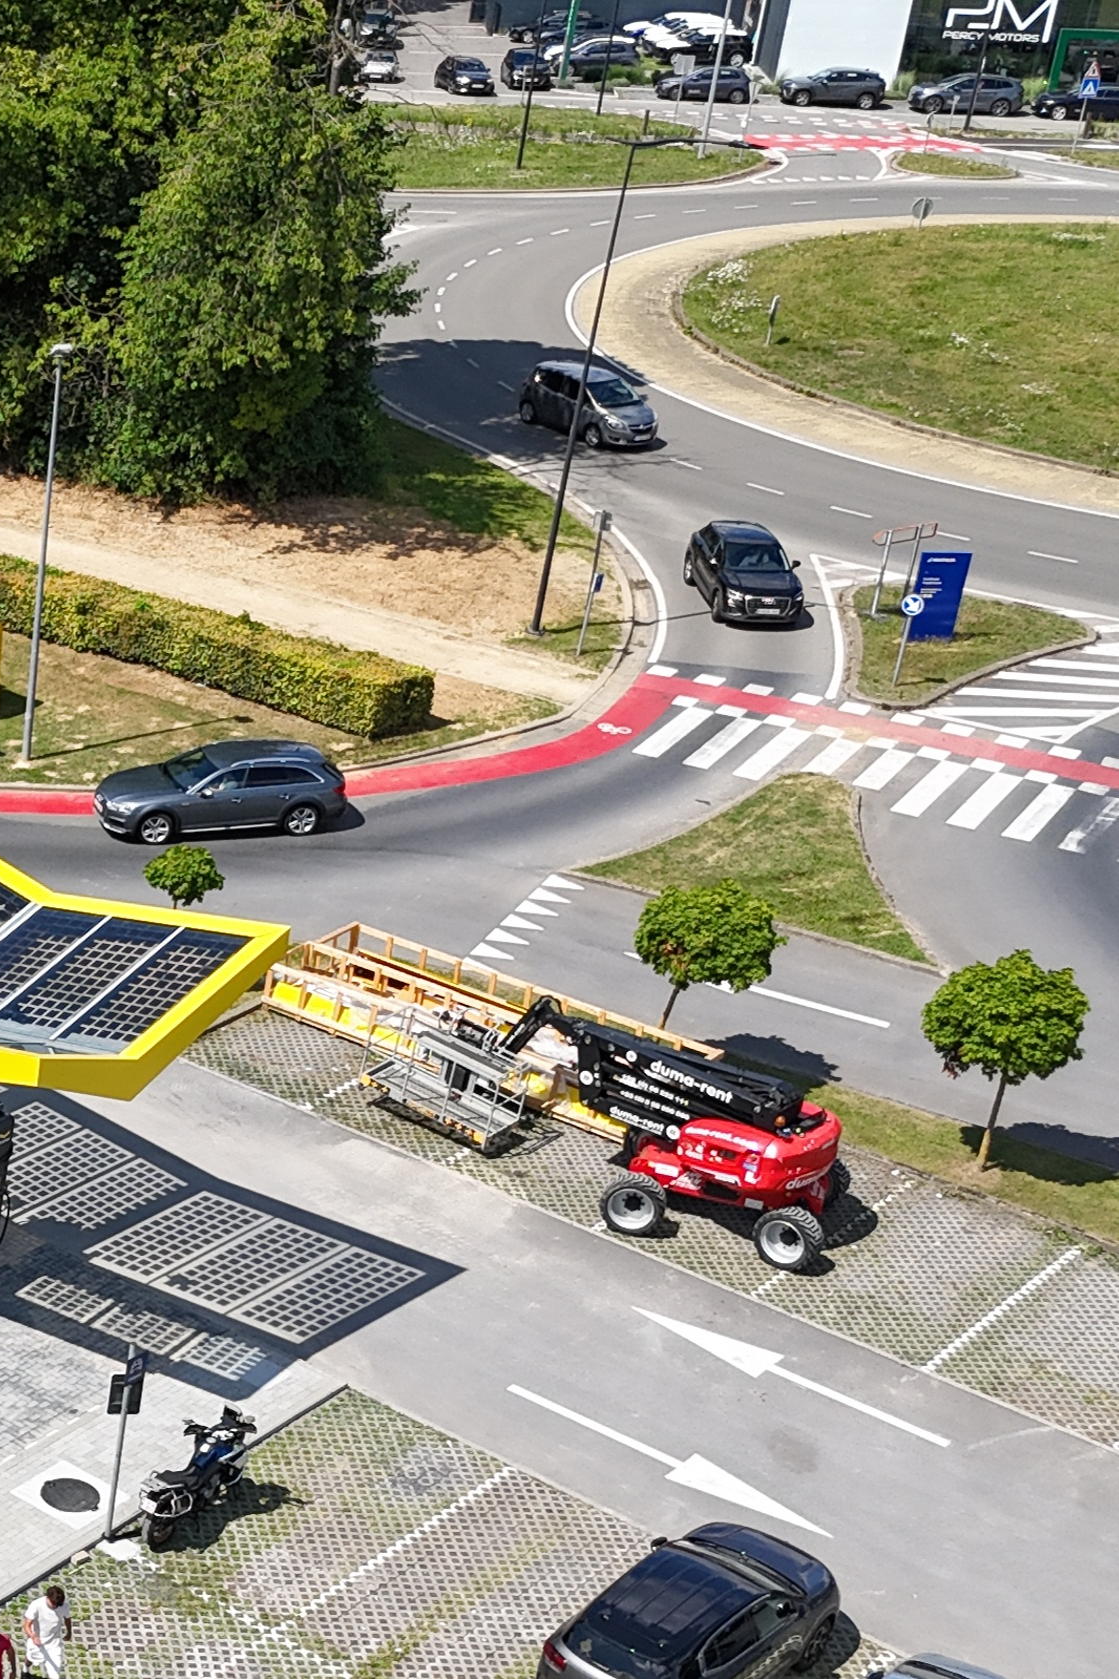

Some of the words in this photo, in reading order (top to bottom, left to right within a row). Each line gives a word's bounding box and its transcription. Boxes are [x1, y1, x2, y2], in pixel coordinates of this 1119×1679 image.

[942, 30, 984, 41] PERCY
[988, 32, 1041, 43] MOTORS
[650, 1060, 733, 1104] duma-rent
[610, 1106, 664, 1132] duma-rent
